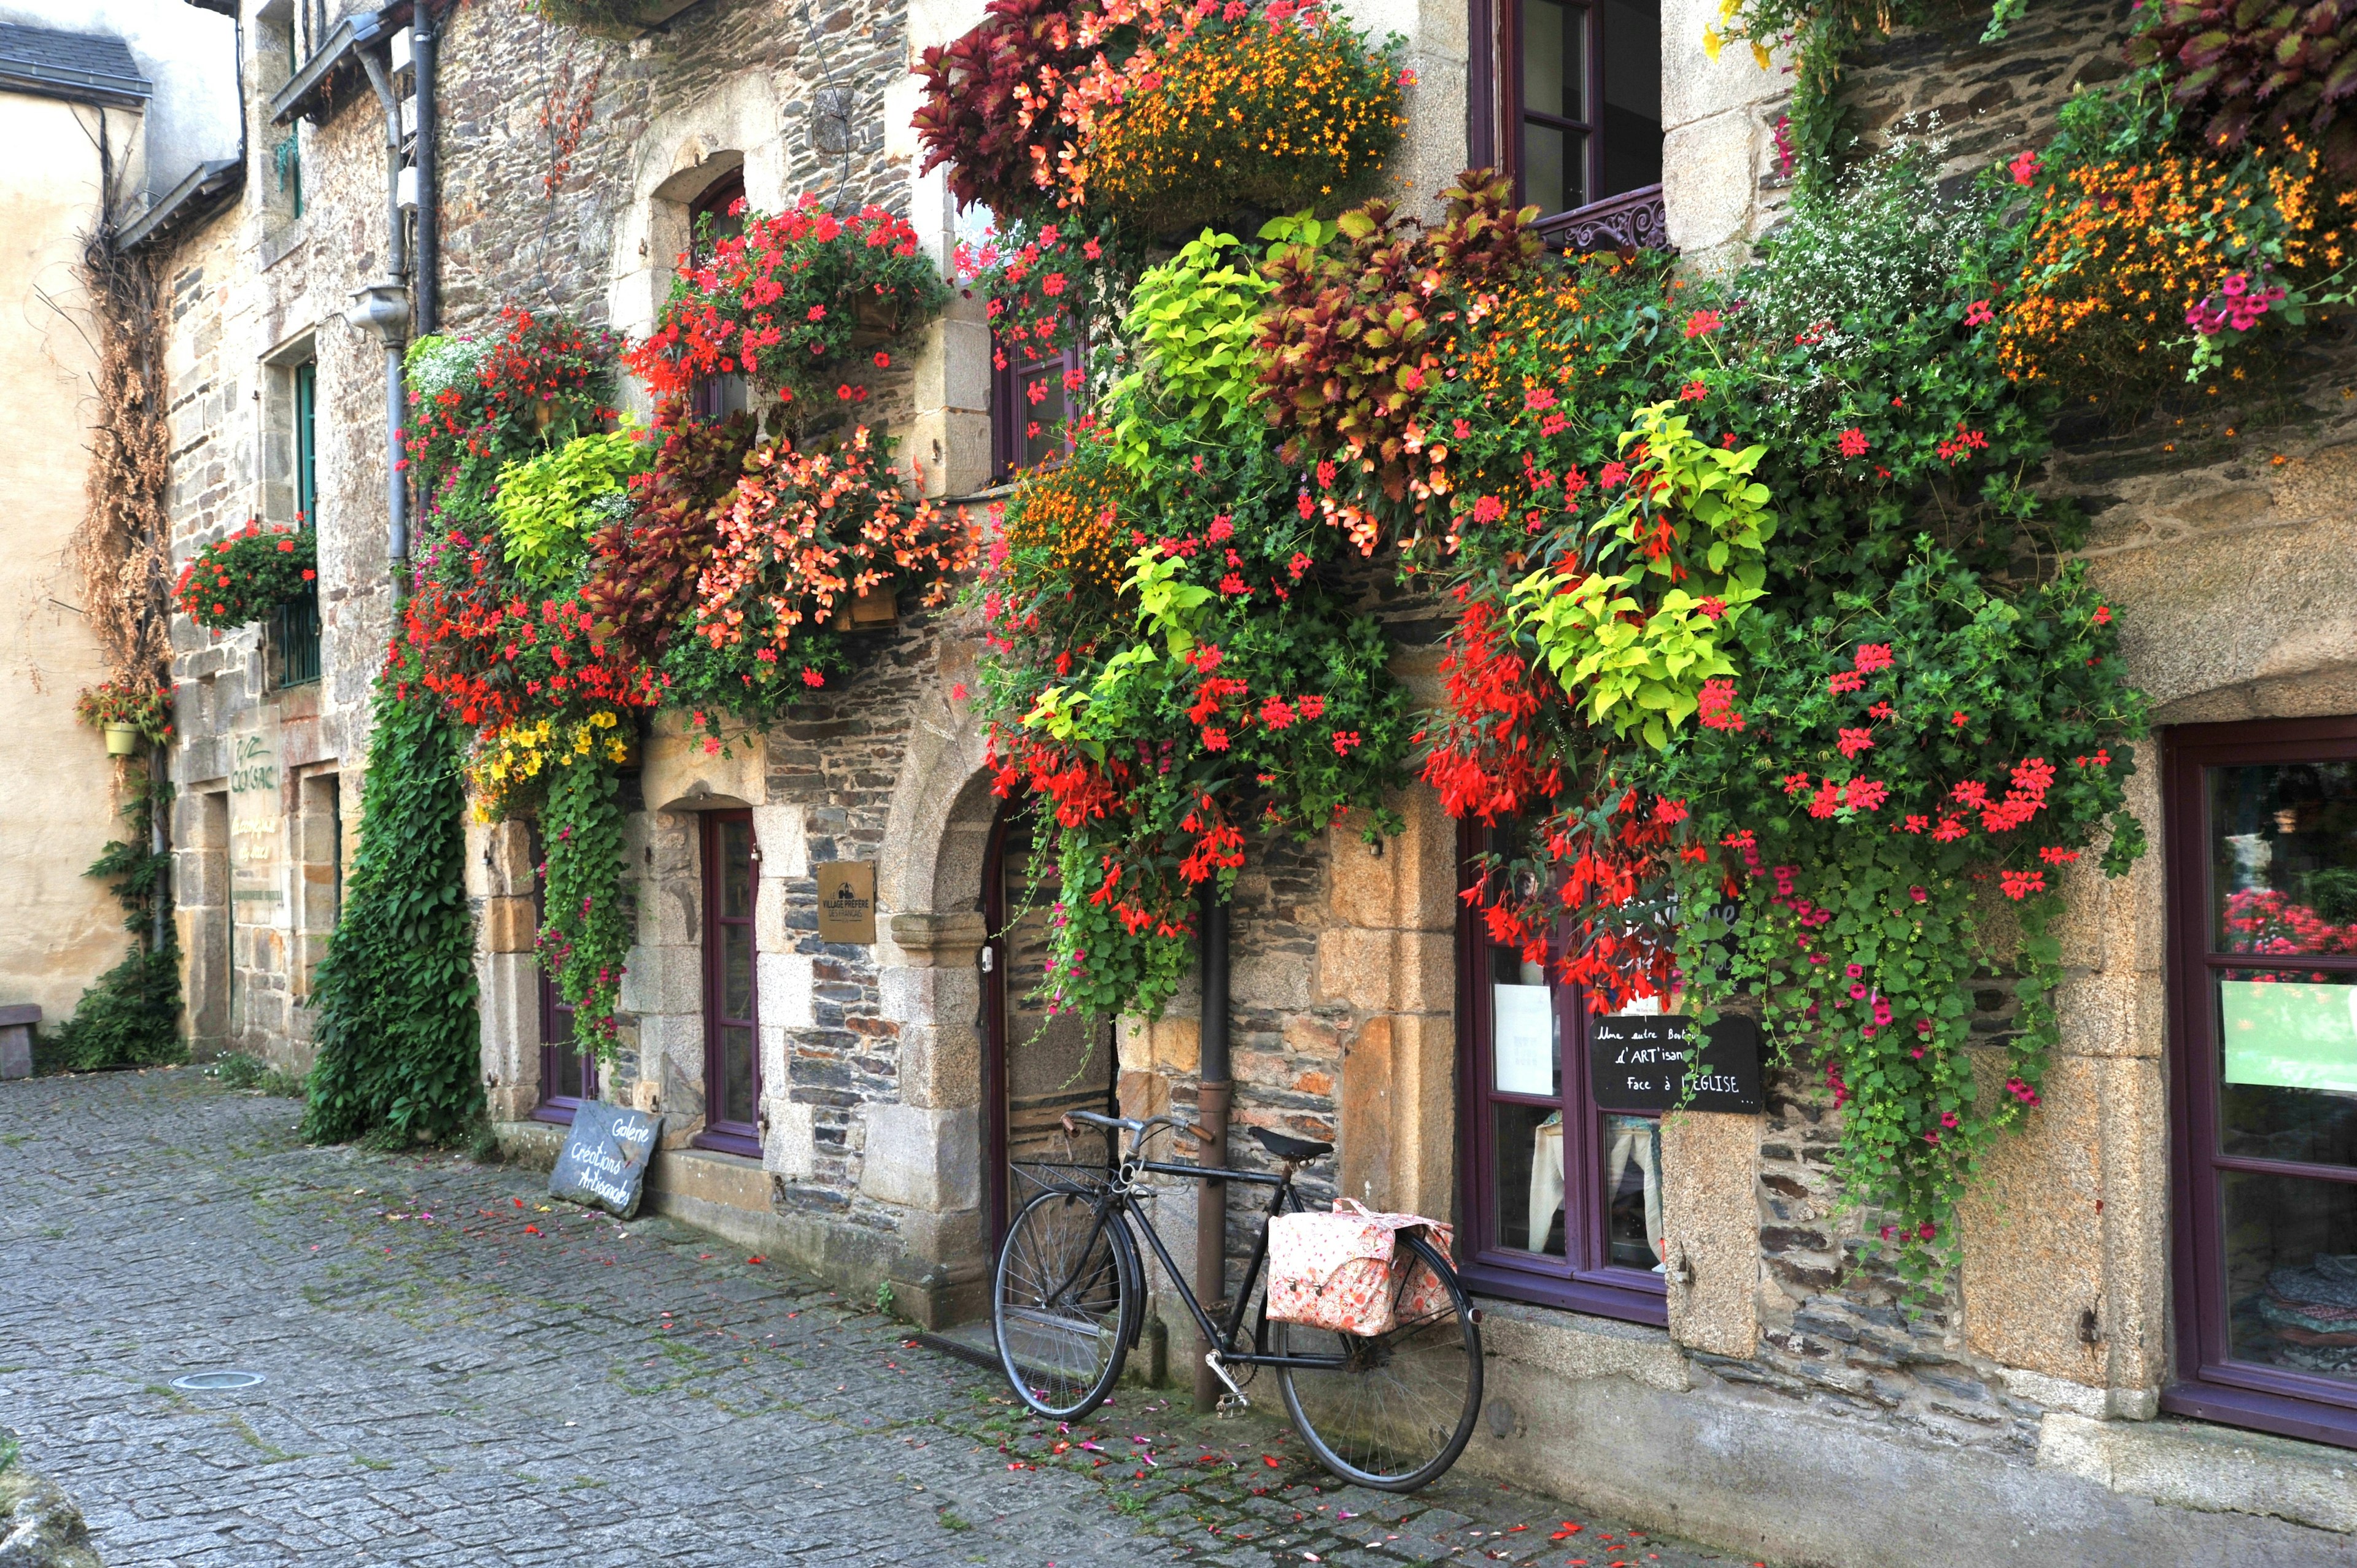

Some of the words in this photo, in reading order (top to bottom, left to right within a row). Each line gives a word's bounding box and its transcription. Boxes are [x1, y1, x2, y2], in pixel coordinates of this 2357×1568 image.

[822, 900, 843, 908] VILLAGE
[845, 898, 869, 908] PRÉFÉRÉ
[1631, 1029, 1658, 1040] autre
[1627, 1076, 1652, 1090] Face
[1664, 1075, 1671, 1091] à
[612, 1116, 649, 1143] Galerie
[571, 1141, 621, 1175] Créations
[578, 1166, 630, 1206] Artisanales
